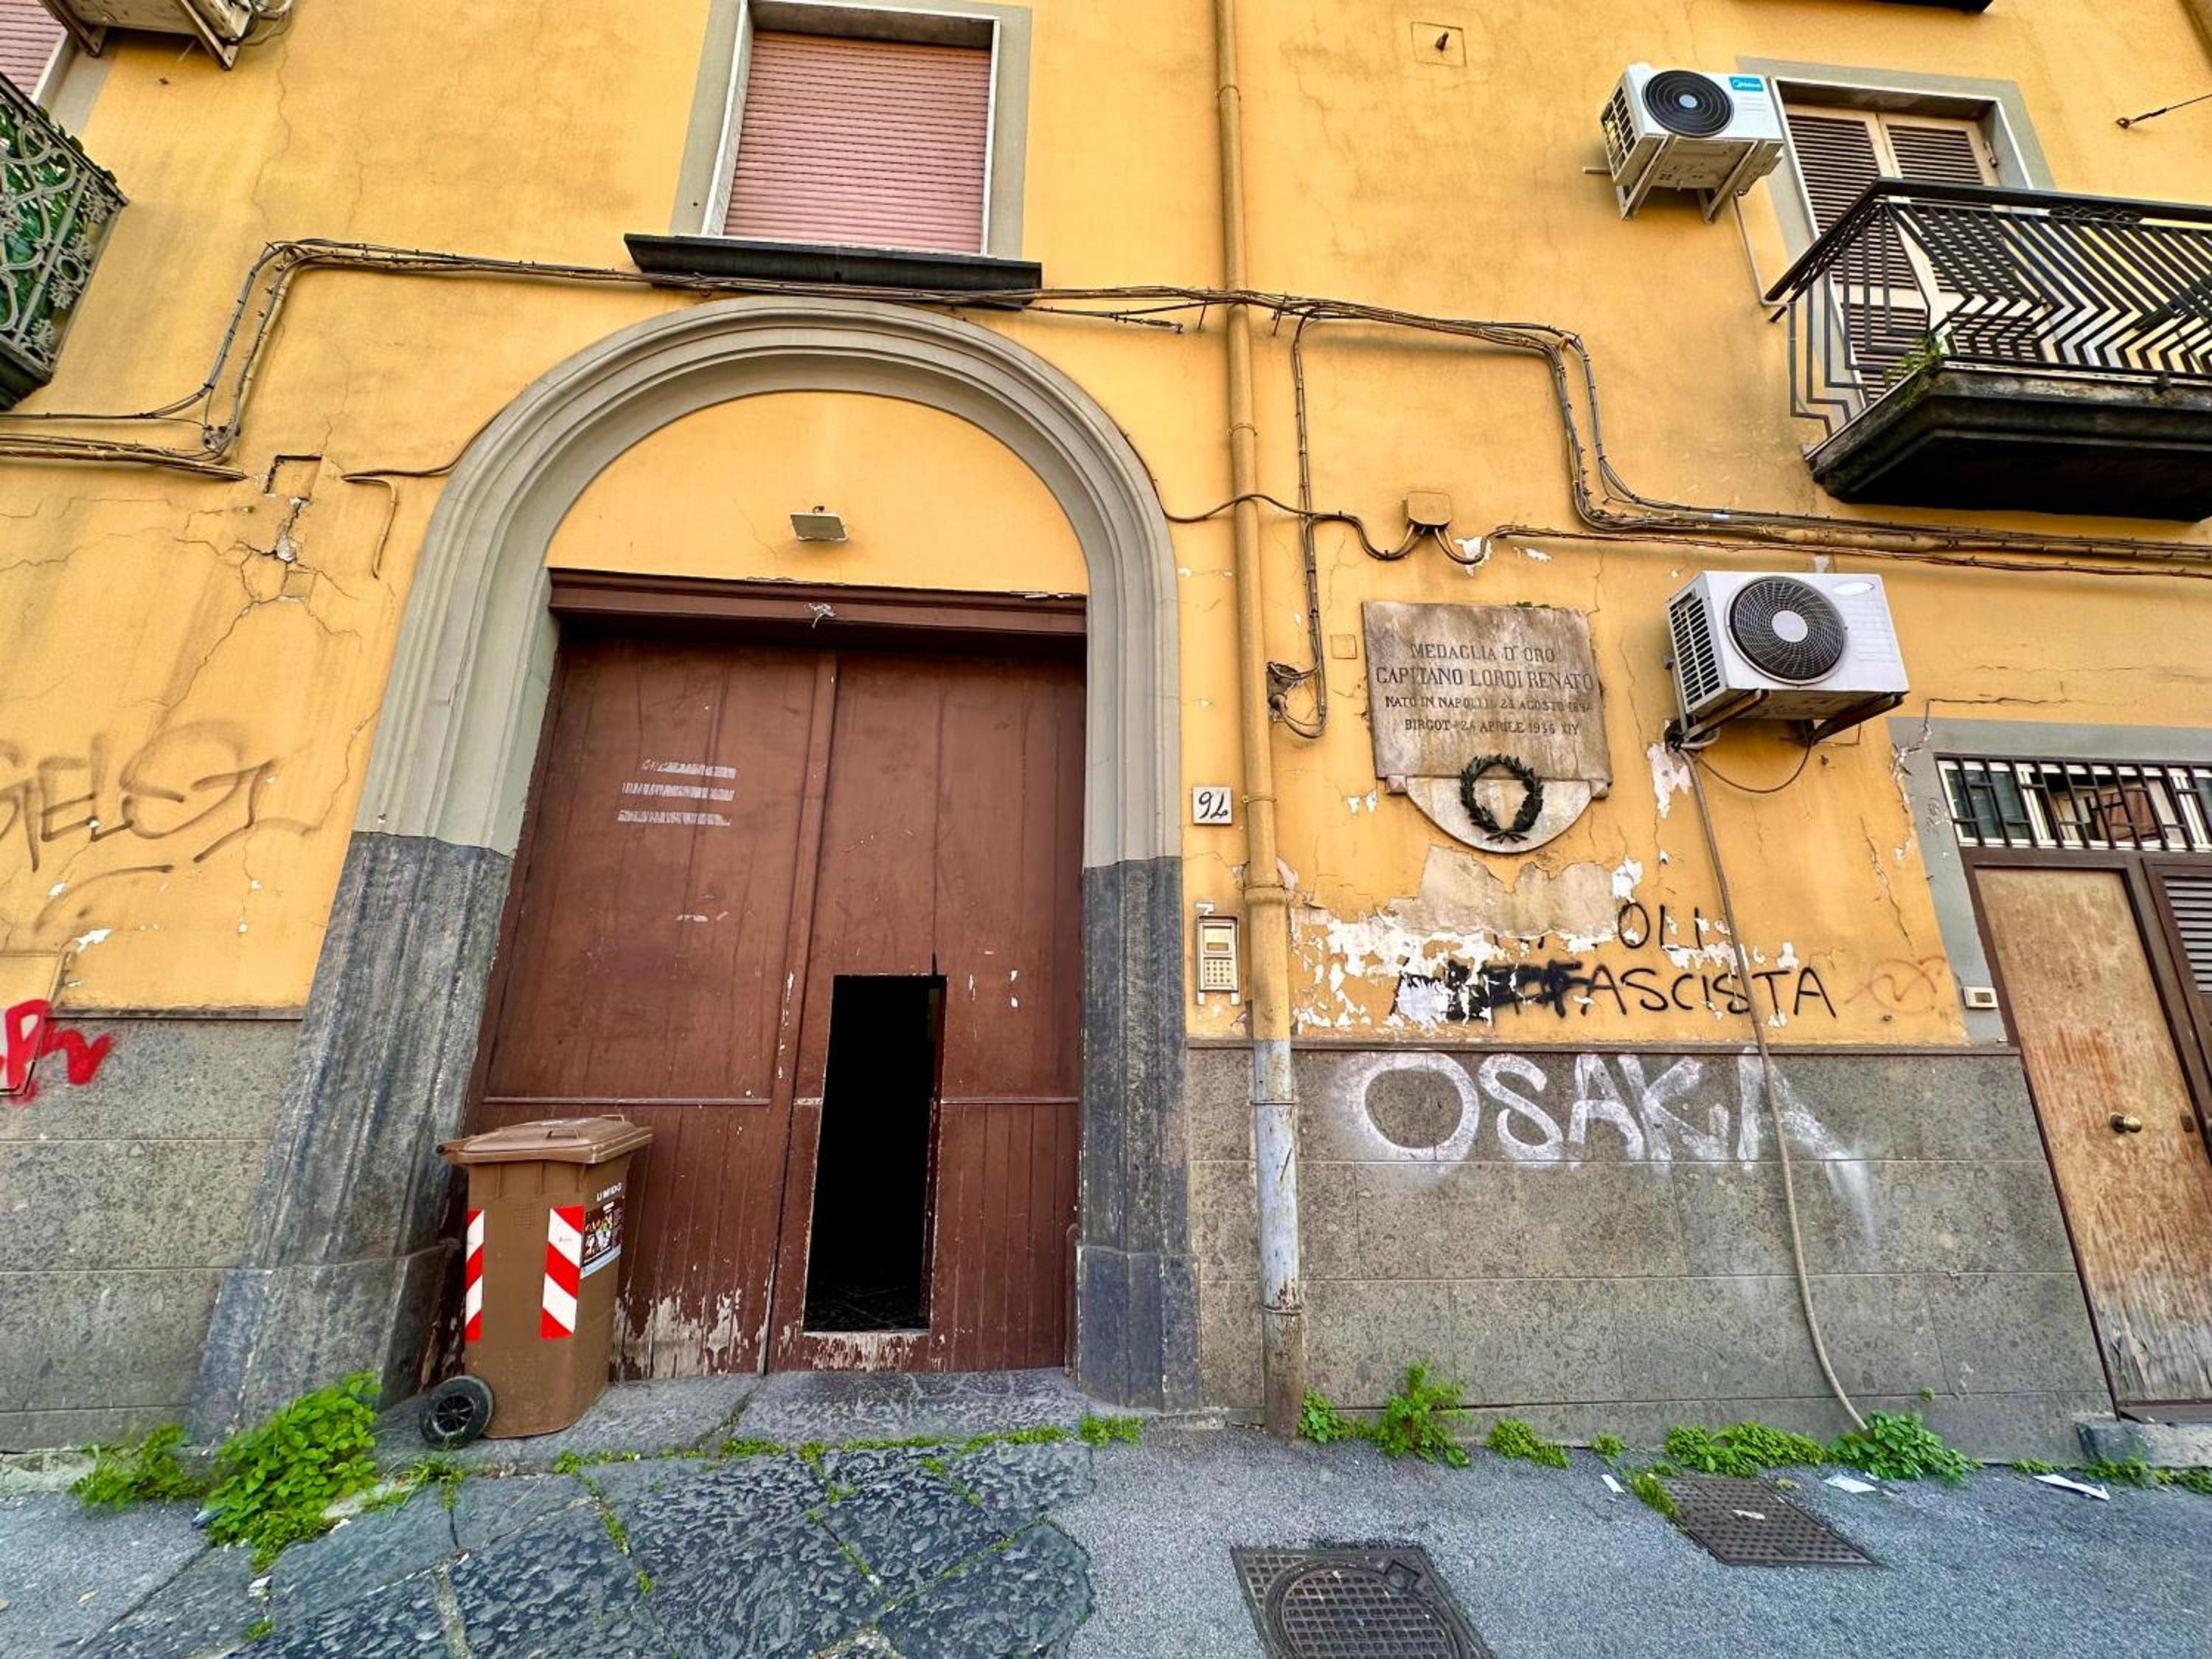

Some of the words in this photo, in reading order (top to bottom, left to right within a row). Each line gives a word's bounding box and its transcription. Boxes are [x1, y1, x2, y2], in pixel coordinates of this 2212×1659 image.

[1411, 644, 1496, 660] MEDAGLIA
[1523, 647, 1555, 663] ORO
[1376, 666, 1463, 686] CAPITANO
[1469, 669, 1523, 688] LORDI
[1527, 671, 1594, 691] RENATO
[1385, 695, 1416, 708] NATO
[1420, 696, 1436, 707] IN
[1518, 700, 1565, 712] AGOSTO
[1405, 719, 1451, 731] BIRGOT
[1480, 720, 1524, 734] APRILE
